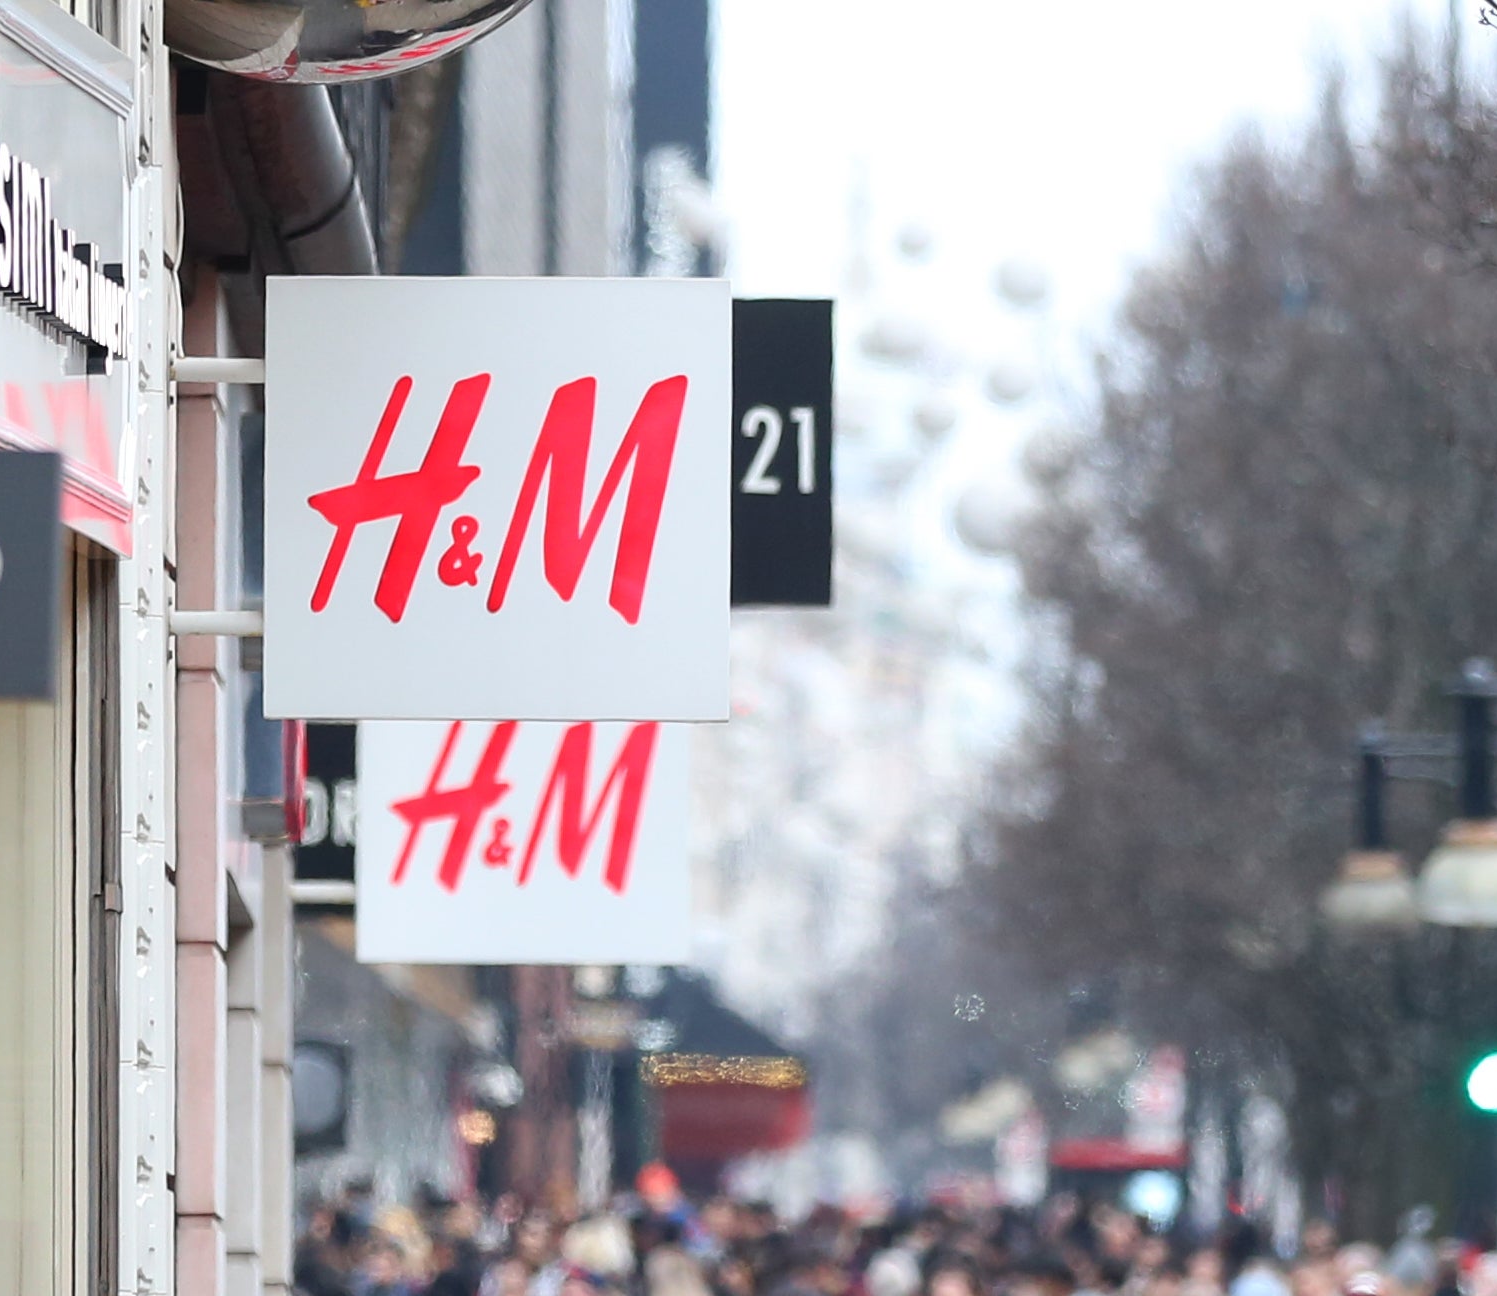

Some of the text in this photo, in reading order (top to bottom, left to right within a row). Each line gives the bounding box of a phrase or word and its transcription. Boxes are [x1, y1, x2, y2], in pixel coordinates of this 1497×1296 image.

[307, 372, 689, 626] H&M
[741, 407, 816, 495] 21
[390, 721, 661, 895] H&M
